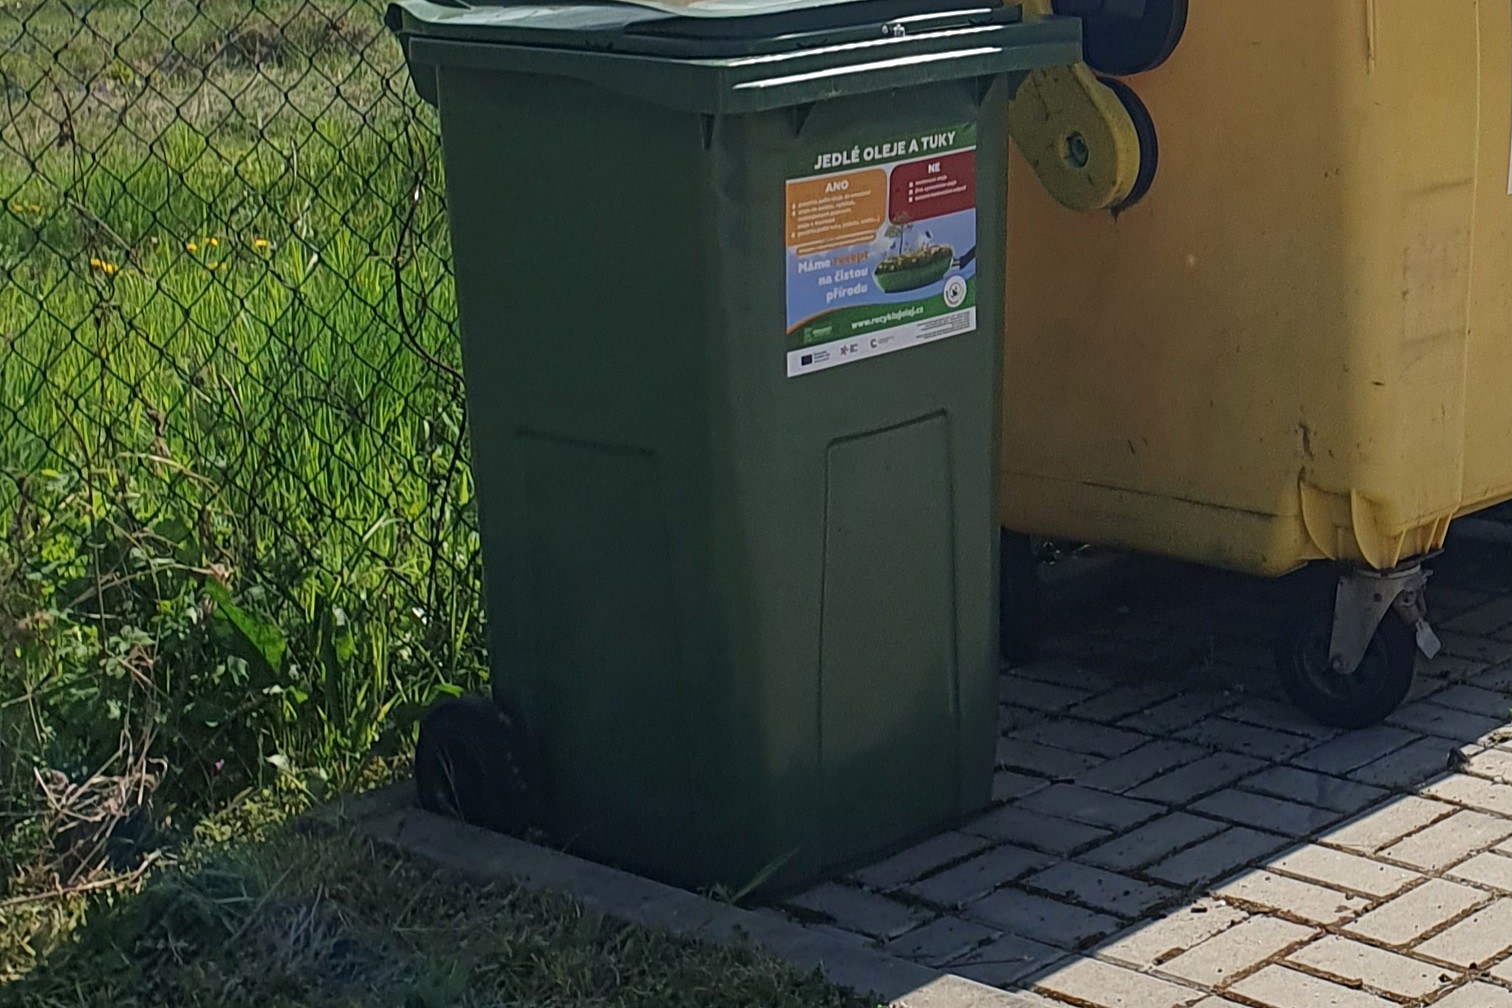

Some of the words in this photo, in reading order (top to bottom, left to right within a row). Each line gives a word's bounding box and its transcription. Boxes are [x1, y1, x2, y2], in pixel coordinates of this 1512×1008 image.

[814, 145, 860, 170] JEDLÉ
[863, 141, 906, 160] OLEJE
[908, 138, 919, 154] A
[921, 131, 957, 150] TUKY
[927, 162, 941, 174] NE
[825, 180, 849, 193] ANO
[798, 258, 831, 273] Máme
[818, 276, 833, 286] na
[834, 267, 869, 283] čistou
[826, 283, 868, 304] přírodu
